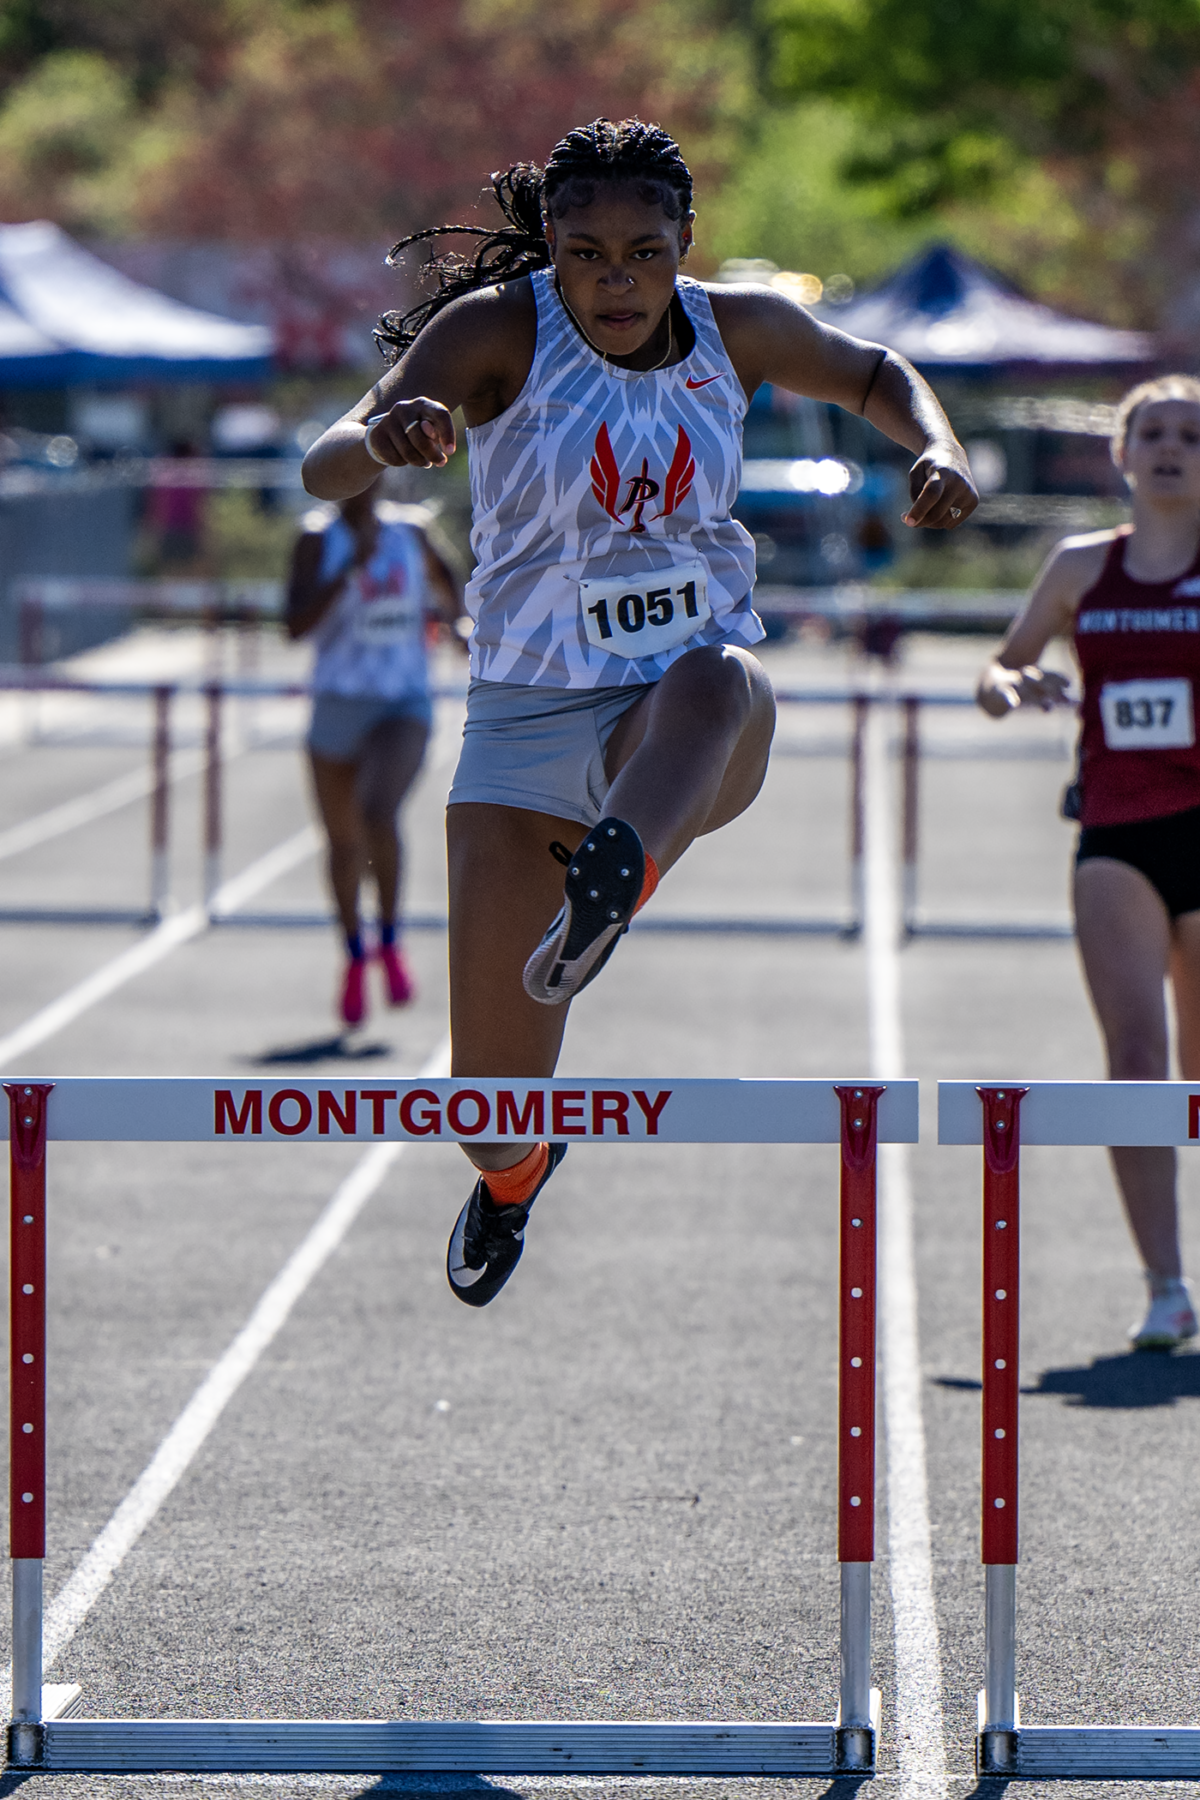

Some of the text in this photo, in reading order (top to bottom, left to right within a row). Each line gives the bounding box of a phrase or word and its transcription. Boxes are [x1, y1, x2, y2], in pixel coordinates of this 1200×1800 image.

[587, 581, 699, 640] 1051
[1078, 608, 1200, 633] MONTGOMER
[1115, 698, 1175, 730] 837
[213, 1089, 674, 1137] MONTGOMERY
